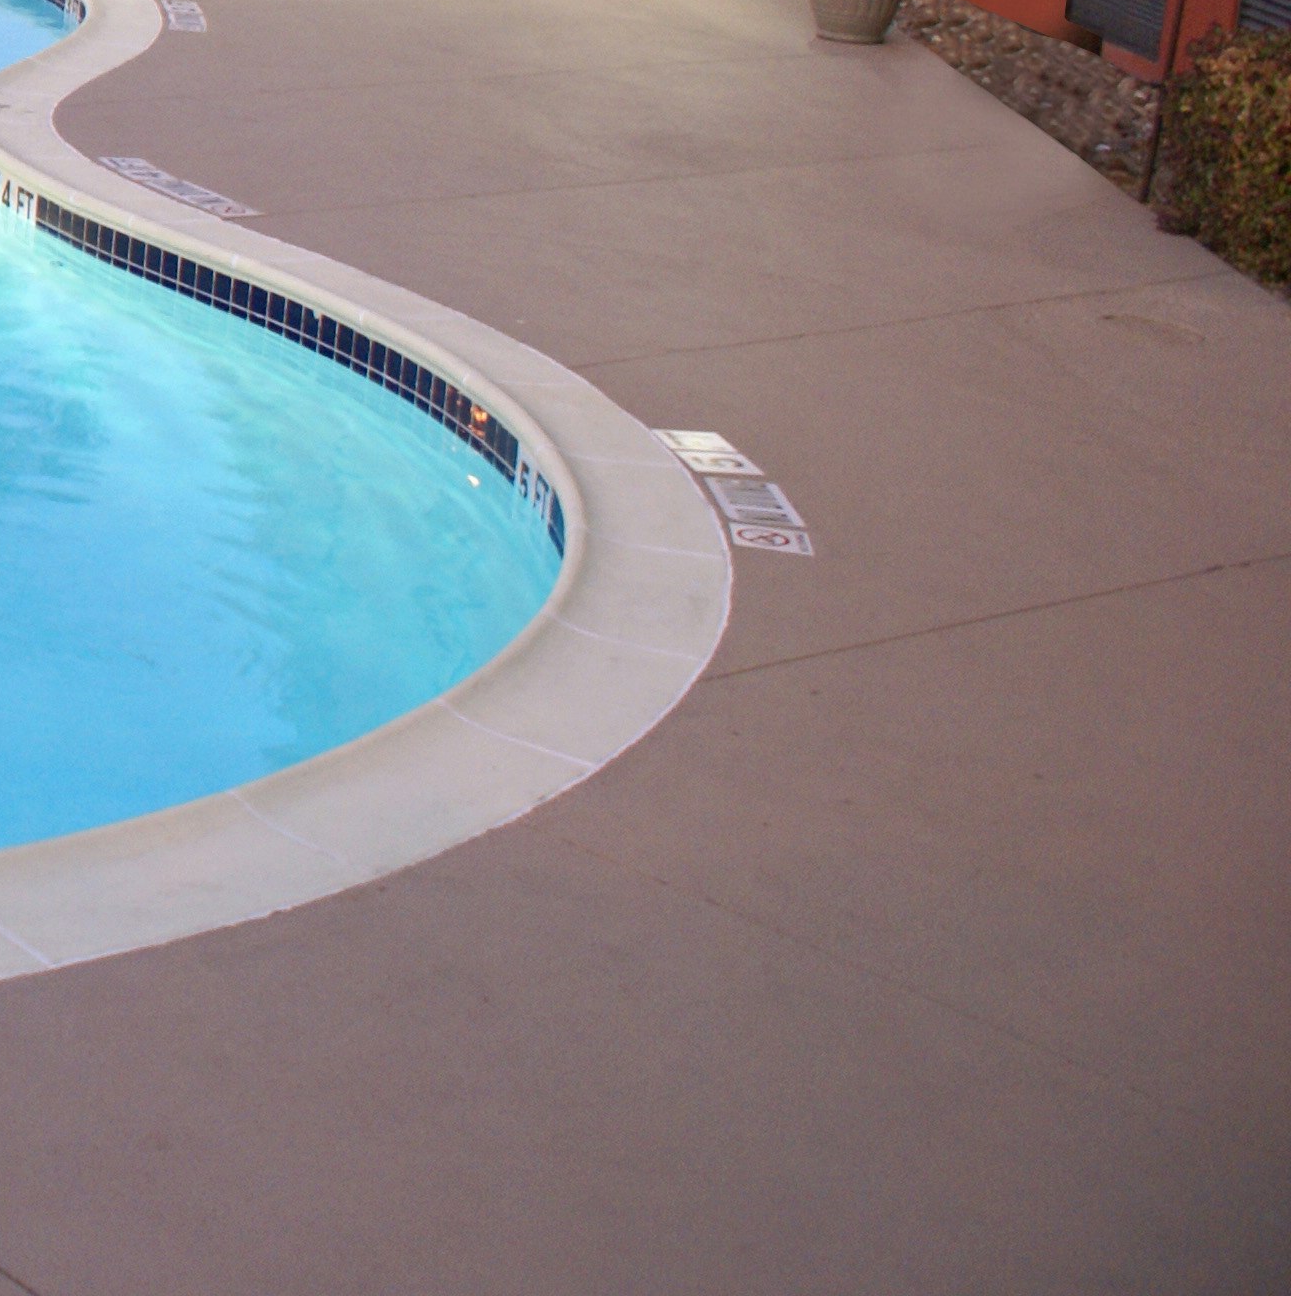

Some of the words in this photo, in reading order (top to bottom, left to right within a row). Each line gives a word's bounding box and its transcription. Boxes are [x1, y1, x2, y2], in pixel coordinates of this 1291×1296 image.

[2, 179, 10, 208] 4
[17, 186, 34, 220] FT
[520, 460, 530, 499] 5
[533, 471, 550, 521] FT
